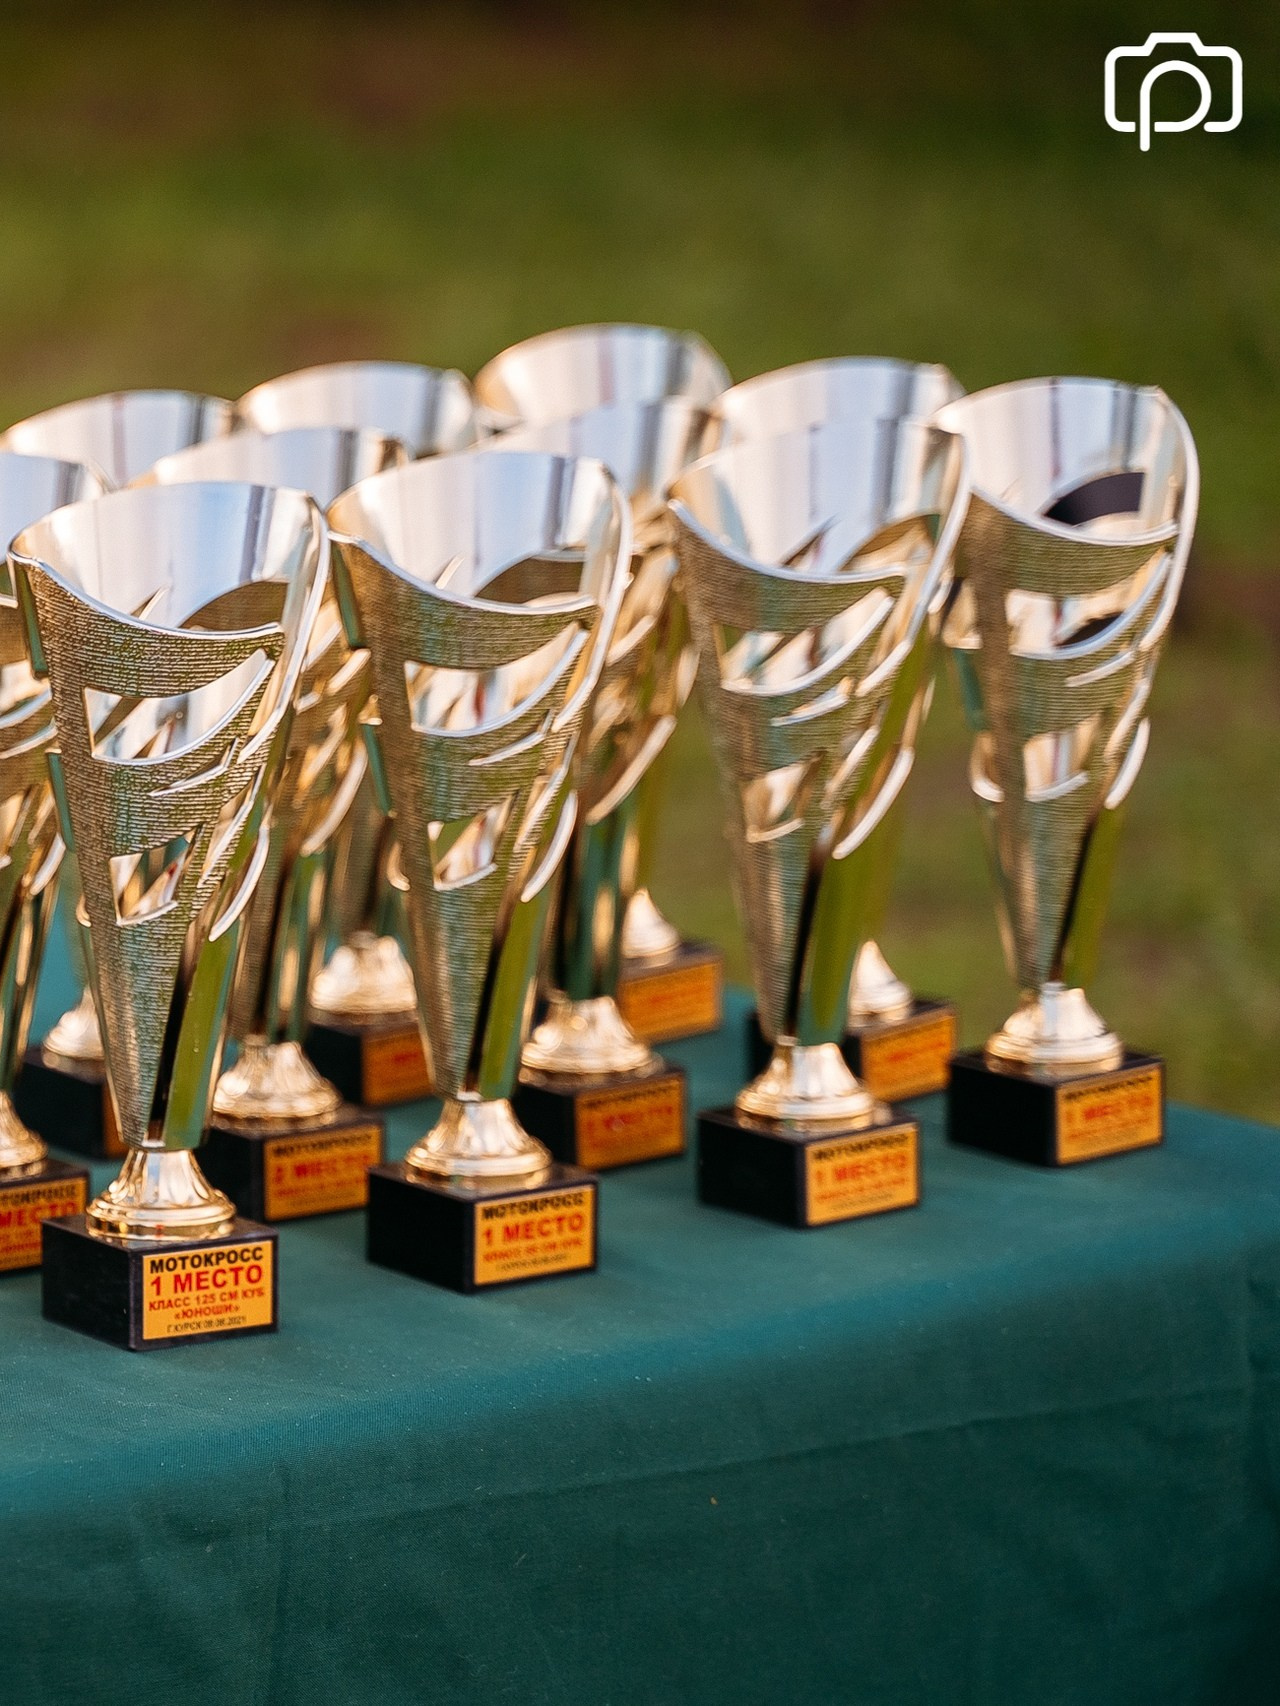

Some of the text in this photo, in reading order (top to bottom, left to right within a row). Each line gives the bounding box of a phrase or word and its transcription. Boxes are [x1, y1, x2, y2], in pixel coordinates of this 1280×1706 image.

[502, 1212, 585, 1243] МЕСТО
[150, 1246, 263, 1275] МОТОКРОСС
[150, 1264, 263, 1297] 1 МЕСТО
[148, 1296, 191, 1312] КЛАСС
[195, 1293, 216, 1305] 125
